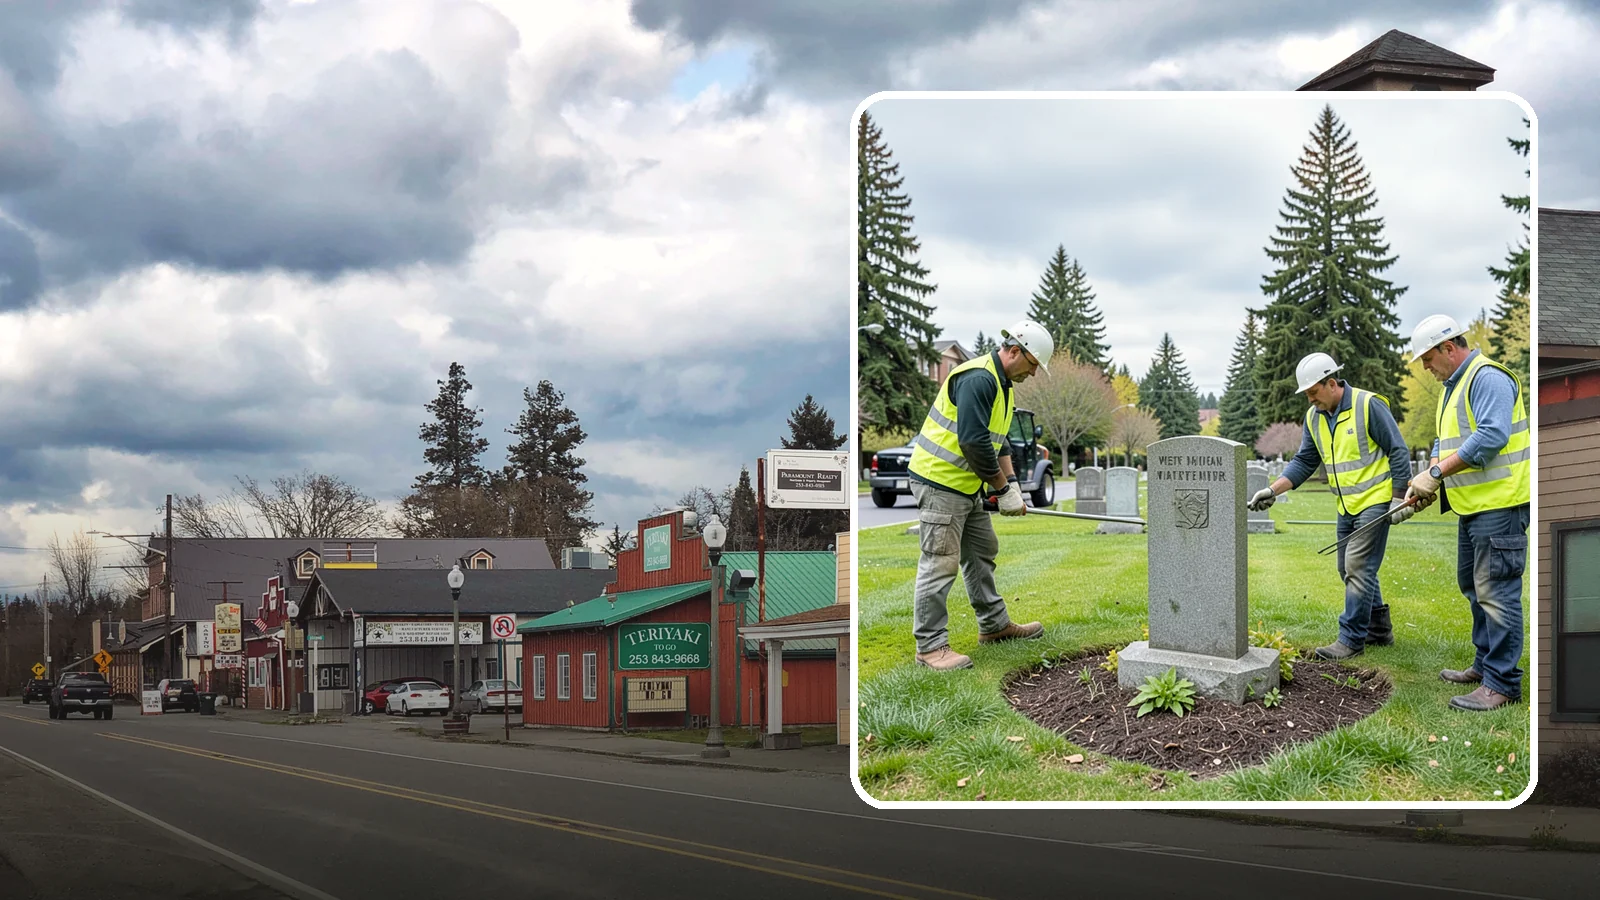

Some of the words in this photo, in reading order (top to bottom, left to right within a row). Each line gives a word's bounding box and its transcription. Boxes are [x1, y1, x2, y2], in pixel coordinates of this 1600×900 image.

[625, 627, 702, 646] TERIYAKI
[629, 655, 648, 664] 253
[651, 654, 700, 664] 843-9668
